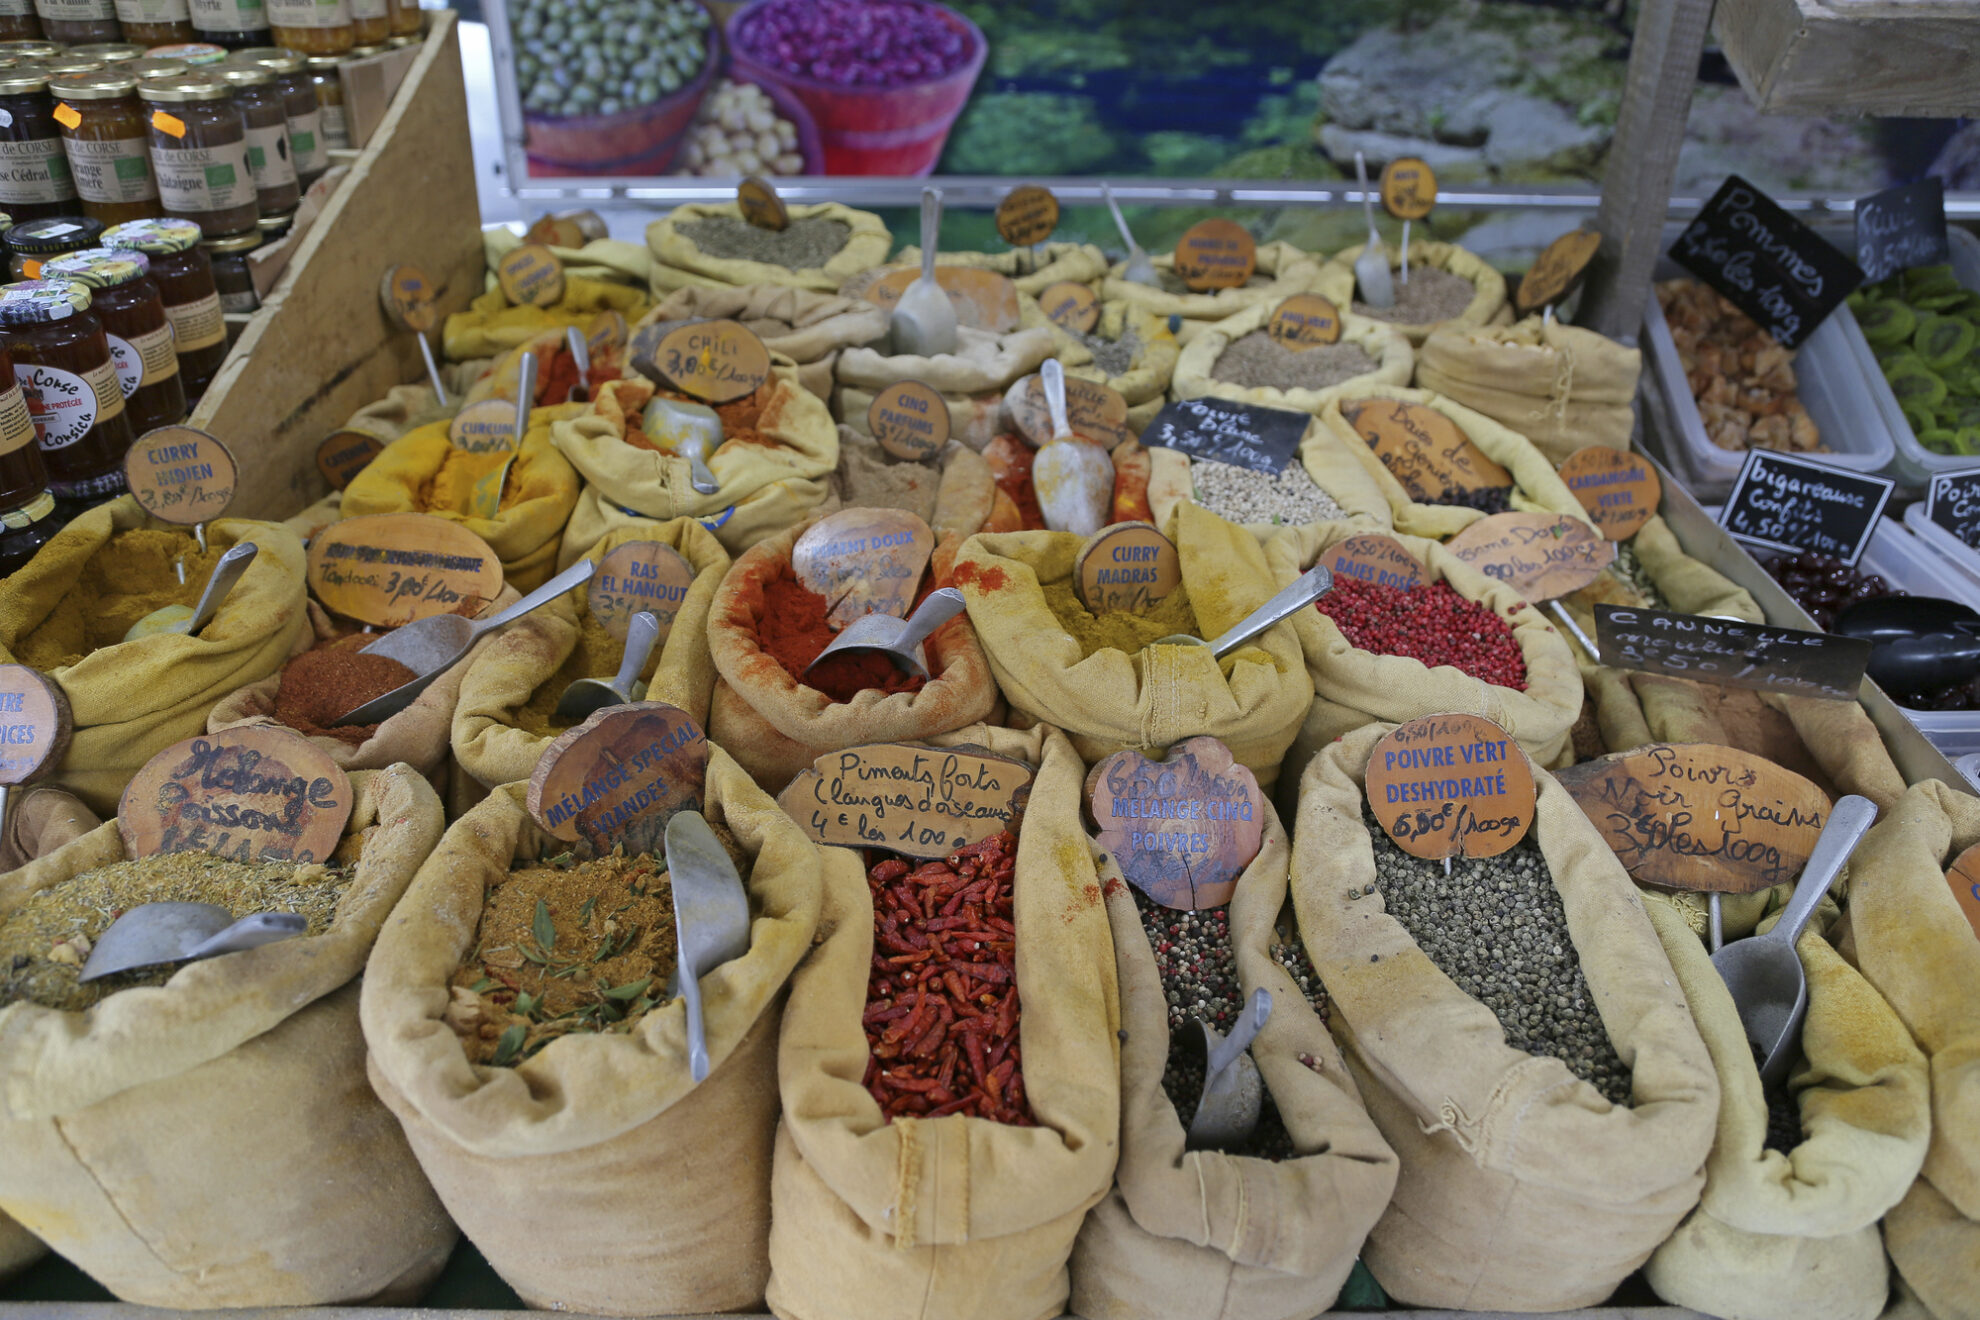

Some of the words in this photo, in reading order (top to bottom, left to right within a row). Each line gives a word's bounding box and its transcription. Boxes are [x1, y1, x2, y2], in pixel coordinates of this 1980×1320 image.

[17, 140, 55, 155] CORSE
[86, 142, 121, 154] CORSE
[11, 168, 50, 182] Cédrat
[74, 164, 102, 177] range
[33, 368, 79, 395] Corse
[898, 394, 929, 414] CINQ
[880, 408, 934, 435] PARFUMS
[147, 442, 198, 465] CURRY
[155, 463, 214, 487] INDIEN
[1597, 490, 1634, 508] VERTE
[811, 538, 866, 559] PIMENT
[870, 530, 914, 550] DOUX
[1112, 545, 1160, 563] CURRY
[630, 560, 659, 580] RAS
[1097, 567, 1158, 585] MADRAS
[1335, 556, 1375, 581] BAIES
[601, 575, 617, 593] EL
[621, 578, 689, 603] HANOUT
[1377, 569, 1421, 593] ROSE
[1609, 612, 1825, 646] CANNELLE
[1385, 745, 1456, 771] POIVRE
[1460, 740, 1508, 764] VERT
[545, 762, 632, 829] MÉLANGE
[631, 721, 700, 774] SPECIAL
[839, 753, 933, 786] Piments
[939, 755, 1000, 801] forts
[1385, 767, 1507, 803] DESHYDRATÉ
[592, 776, 670, 835] VIANDES
[1112, 797, 1201, 820] MELANGE
[1207, 800, 1253, 822] CINQ
[1718, 789, 1823, 834] Grains
[1131, 831, 1210, 854] POIVRES
